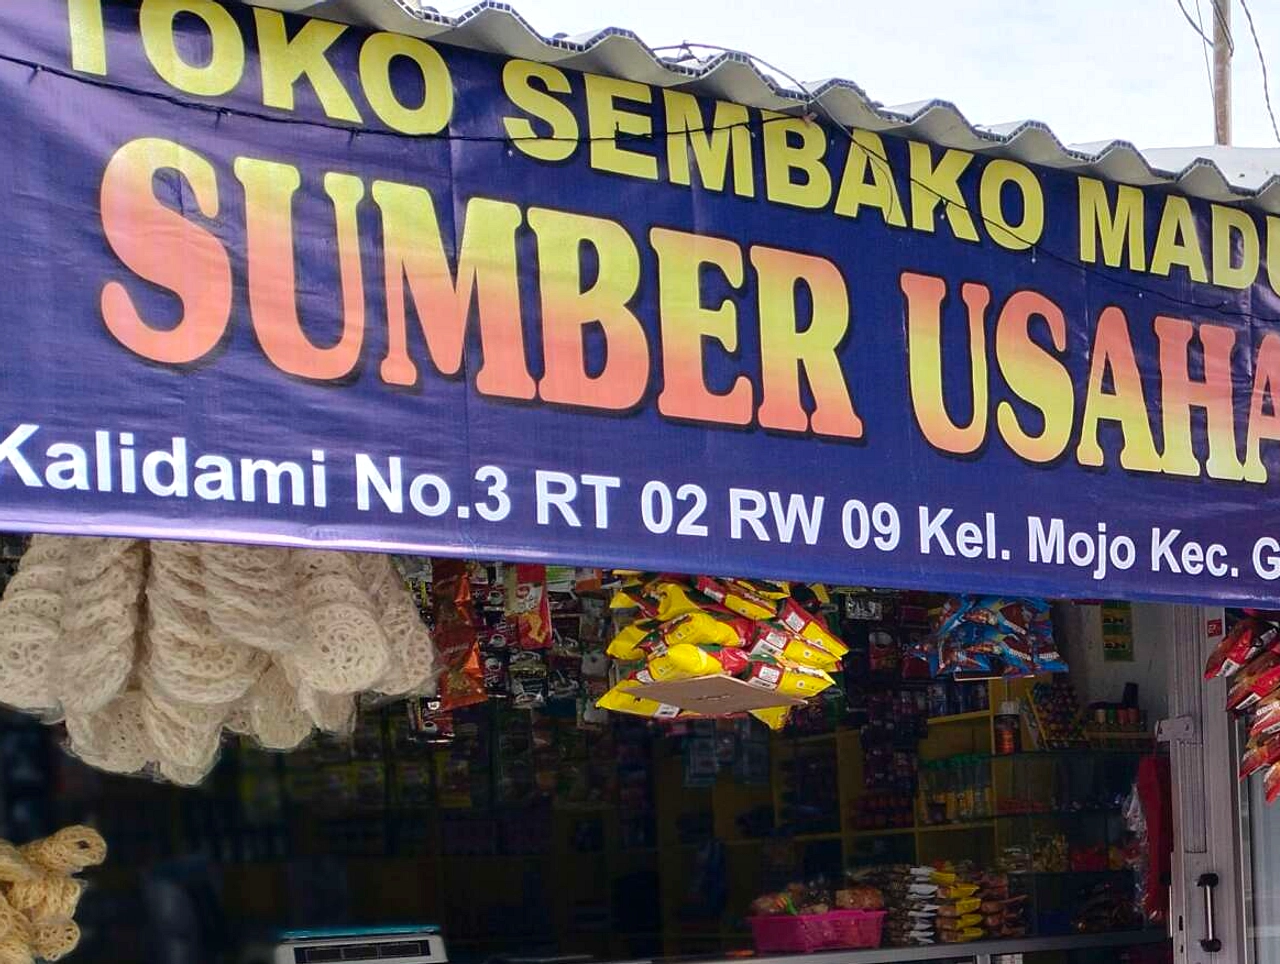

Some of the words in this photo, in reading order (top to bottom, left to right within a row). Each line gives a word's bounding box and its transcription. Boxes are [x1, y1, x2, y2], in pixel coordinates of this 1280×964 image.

[502, 58, 1044, 251] SEMBAKO
[100, 137, 863, 439] SUMBER
[0, 424, 327, 508] Kalidami
[355, 453, 512, 522] No.3
[535, 470, 621, 529] RT
[641, 480, 709, 537] 02
[729, 488, 825, 546] RW
[841, 499, 901, 551] 09
[918, 506, 1010, 561] Kel.
[1027, 515, 1136, 580] Mojo
[1151, 527, 1239, 578] Kec.
